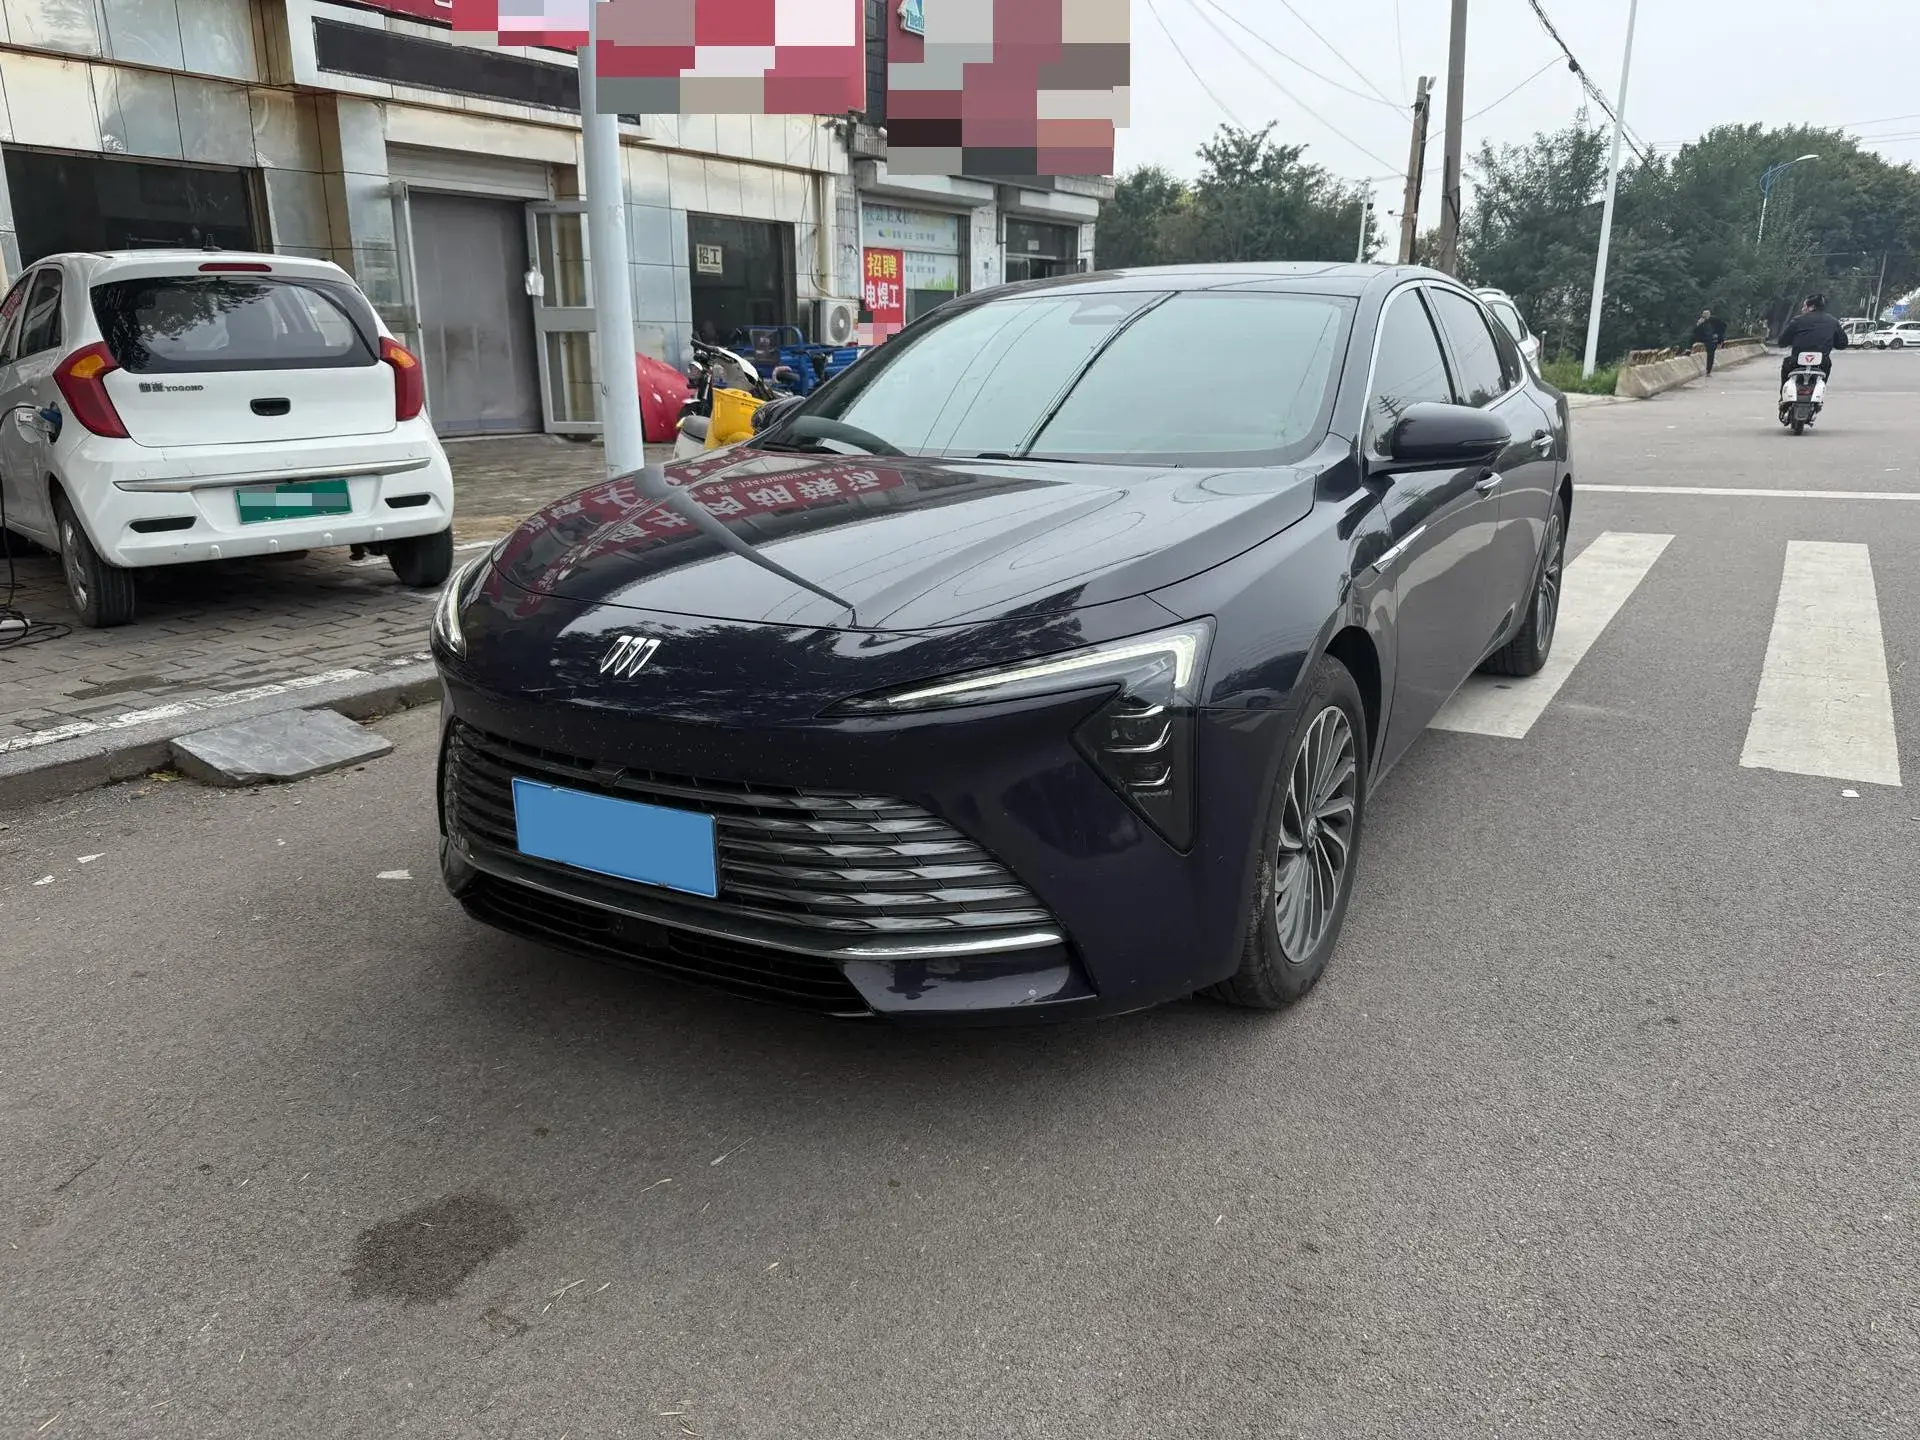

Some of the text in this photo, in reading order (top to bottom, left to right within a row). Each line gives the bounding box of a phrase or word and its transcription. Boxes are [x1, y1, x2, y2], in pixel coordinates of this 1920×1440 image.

[867, 252, 897, 278] 招聘
[865, 282, 900, 310] 电焊工
